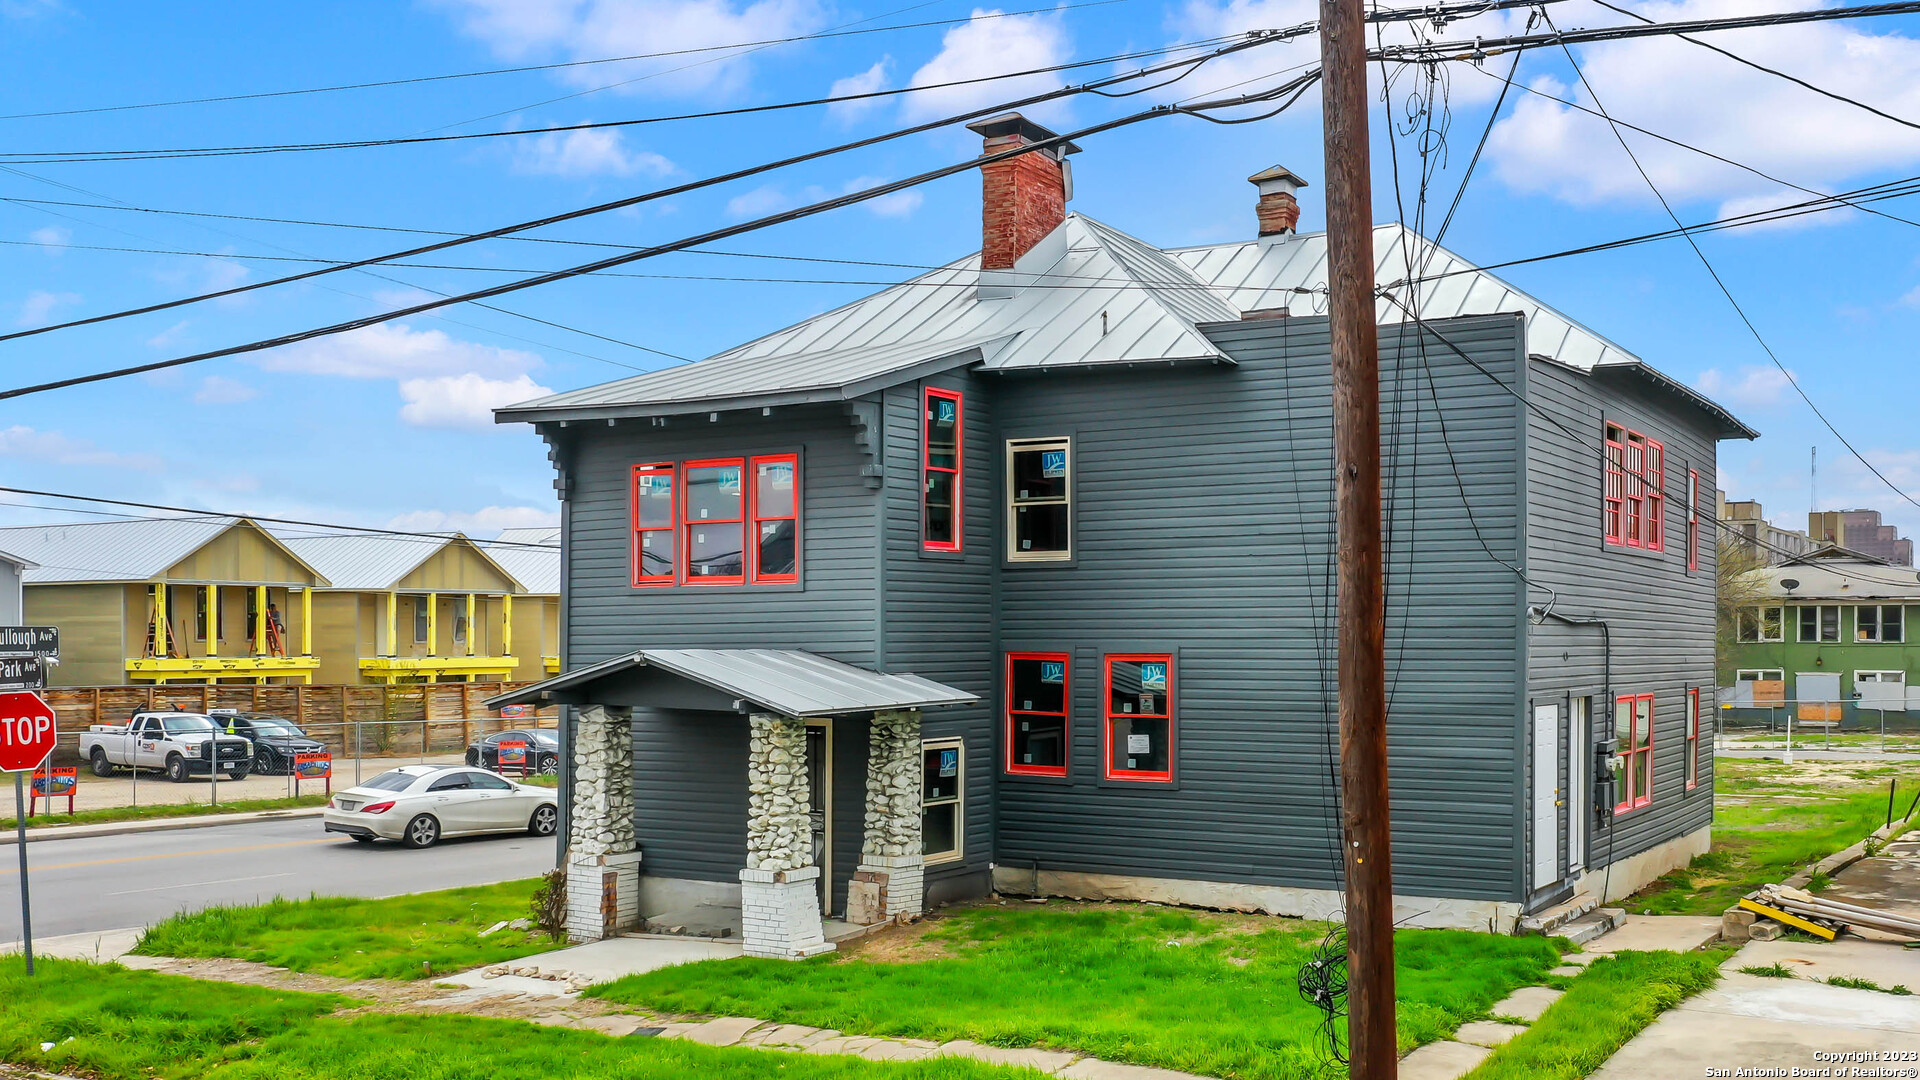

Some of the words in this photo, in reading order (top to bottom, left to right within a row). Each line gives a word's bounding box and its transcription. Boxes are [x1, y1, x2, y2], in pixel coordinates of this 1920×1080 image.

[941, 402, 954, 419] JW
[1046, 453, 1062, 468] JW
[722, 470, 738, 484] JW
[39, 631, 53, 641] Ave
[24, 661, 36, 672] Ave
[1044, 664, 1061, 680] JW
[1143, 666, 1162, 681] JW
[0, 716, 50, 746] TOP
[942, 751, 956, 767] JW
